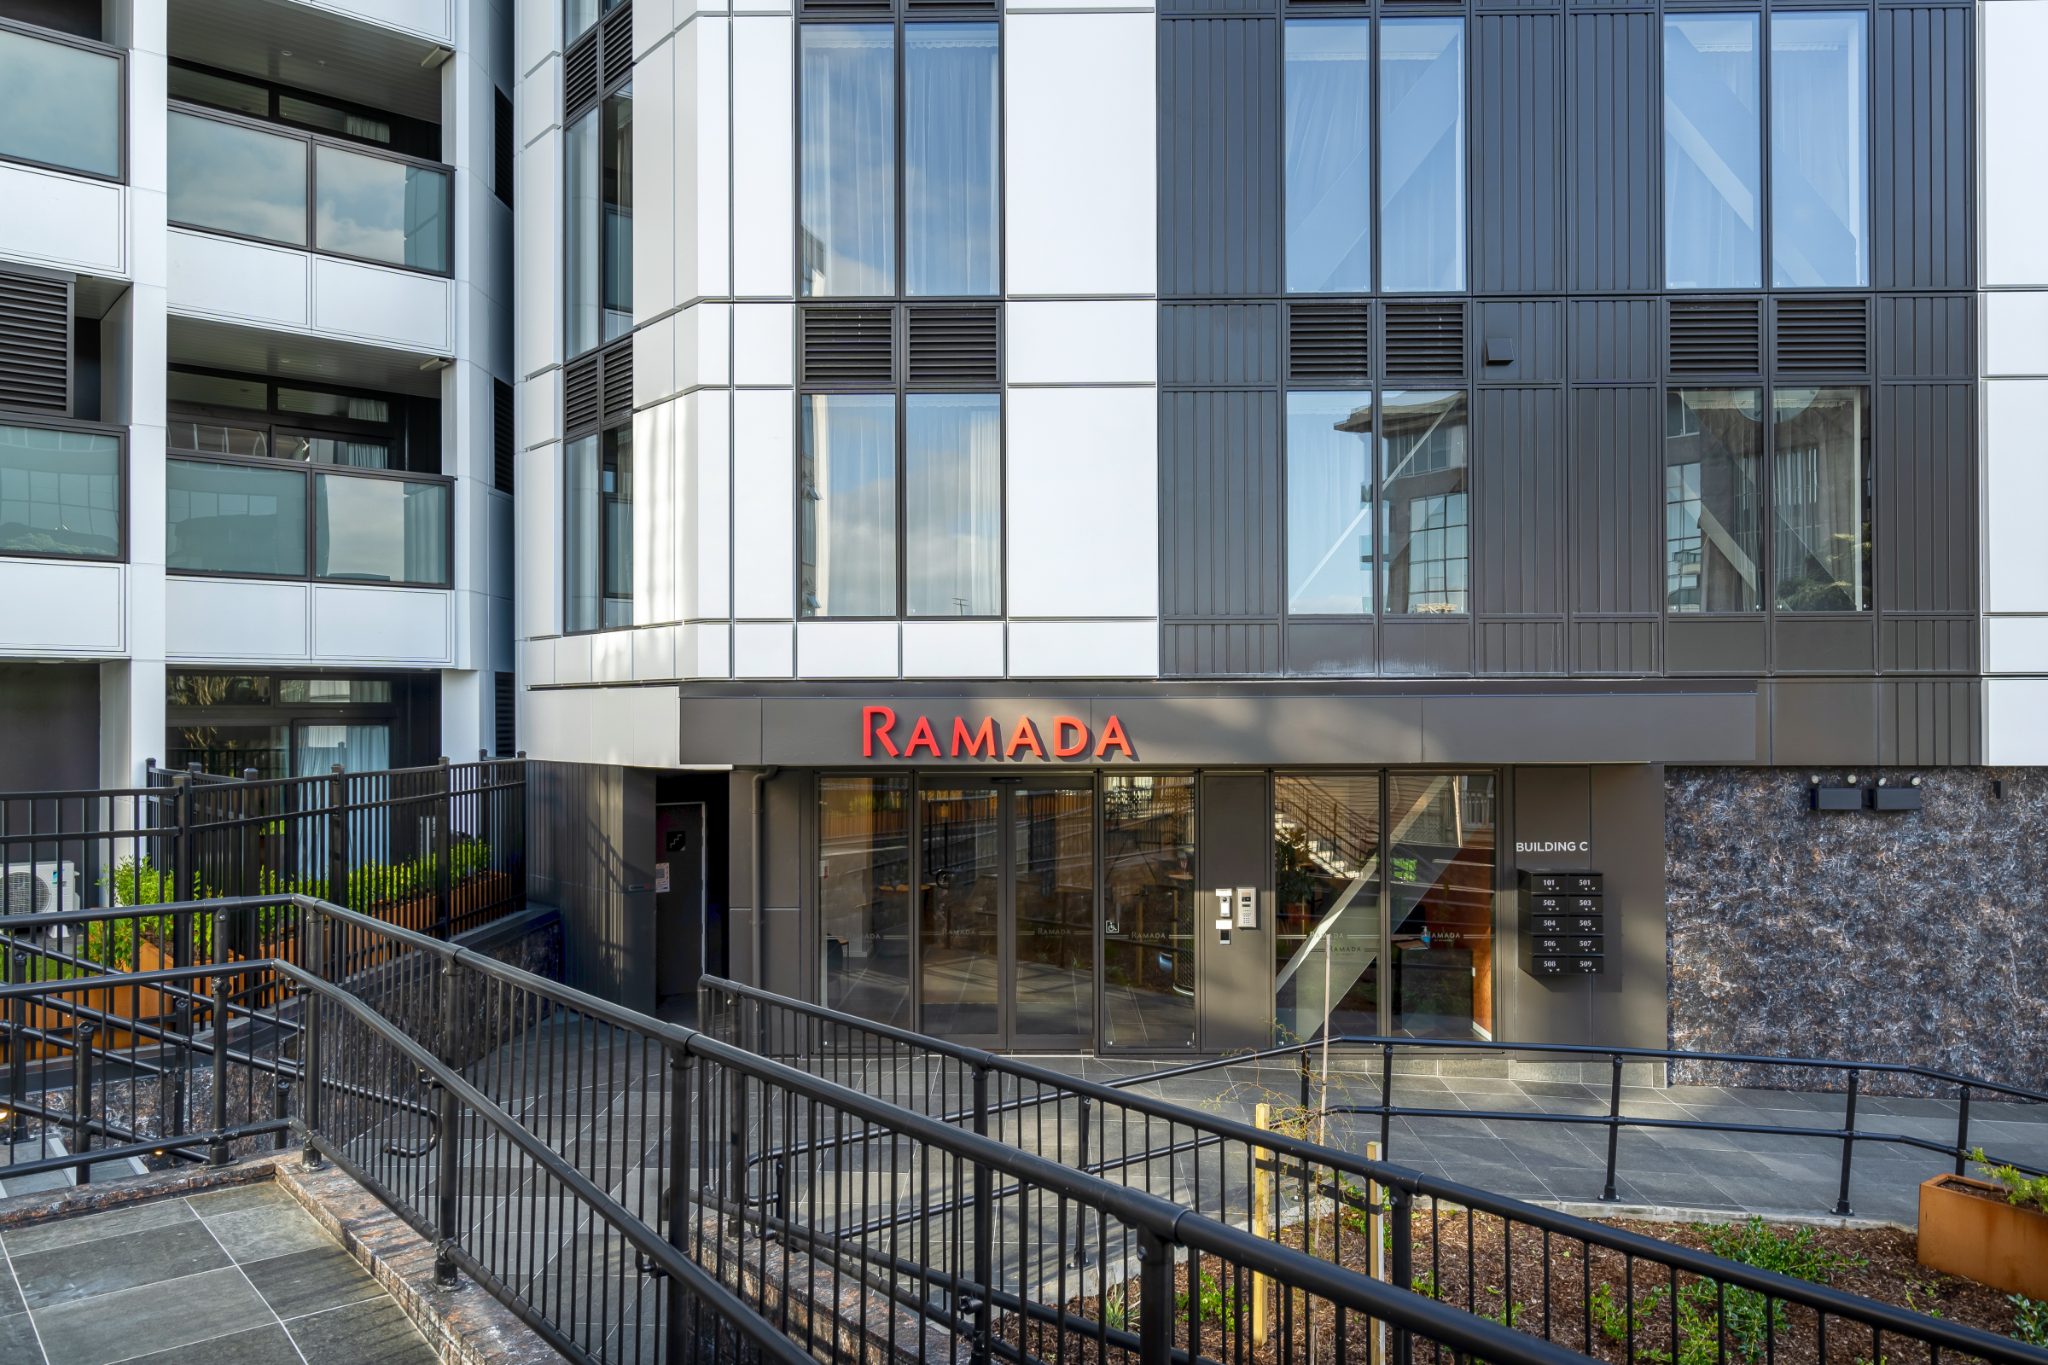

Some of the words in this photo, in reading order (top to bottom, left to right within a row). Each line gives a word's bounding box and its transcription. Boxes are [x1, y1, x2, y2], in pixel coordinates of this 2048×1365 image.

[862, 705, 1133, 757] RAMADA
[1515, 841, 1576, 852] BUILDING
[1579, 841, 1588, 852] C
[1037, 927, 1072, 936] RAMADA
[1131, 931, 1166, 940] RAMADA
[1309, 931, 1344, 940] RADA
